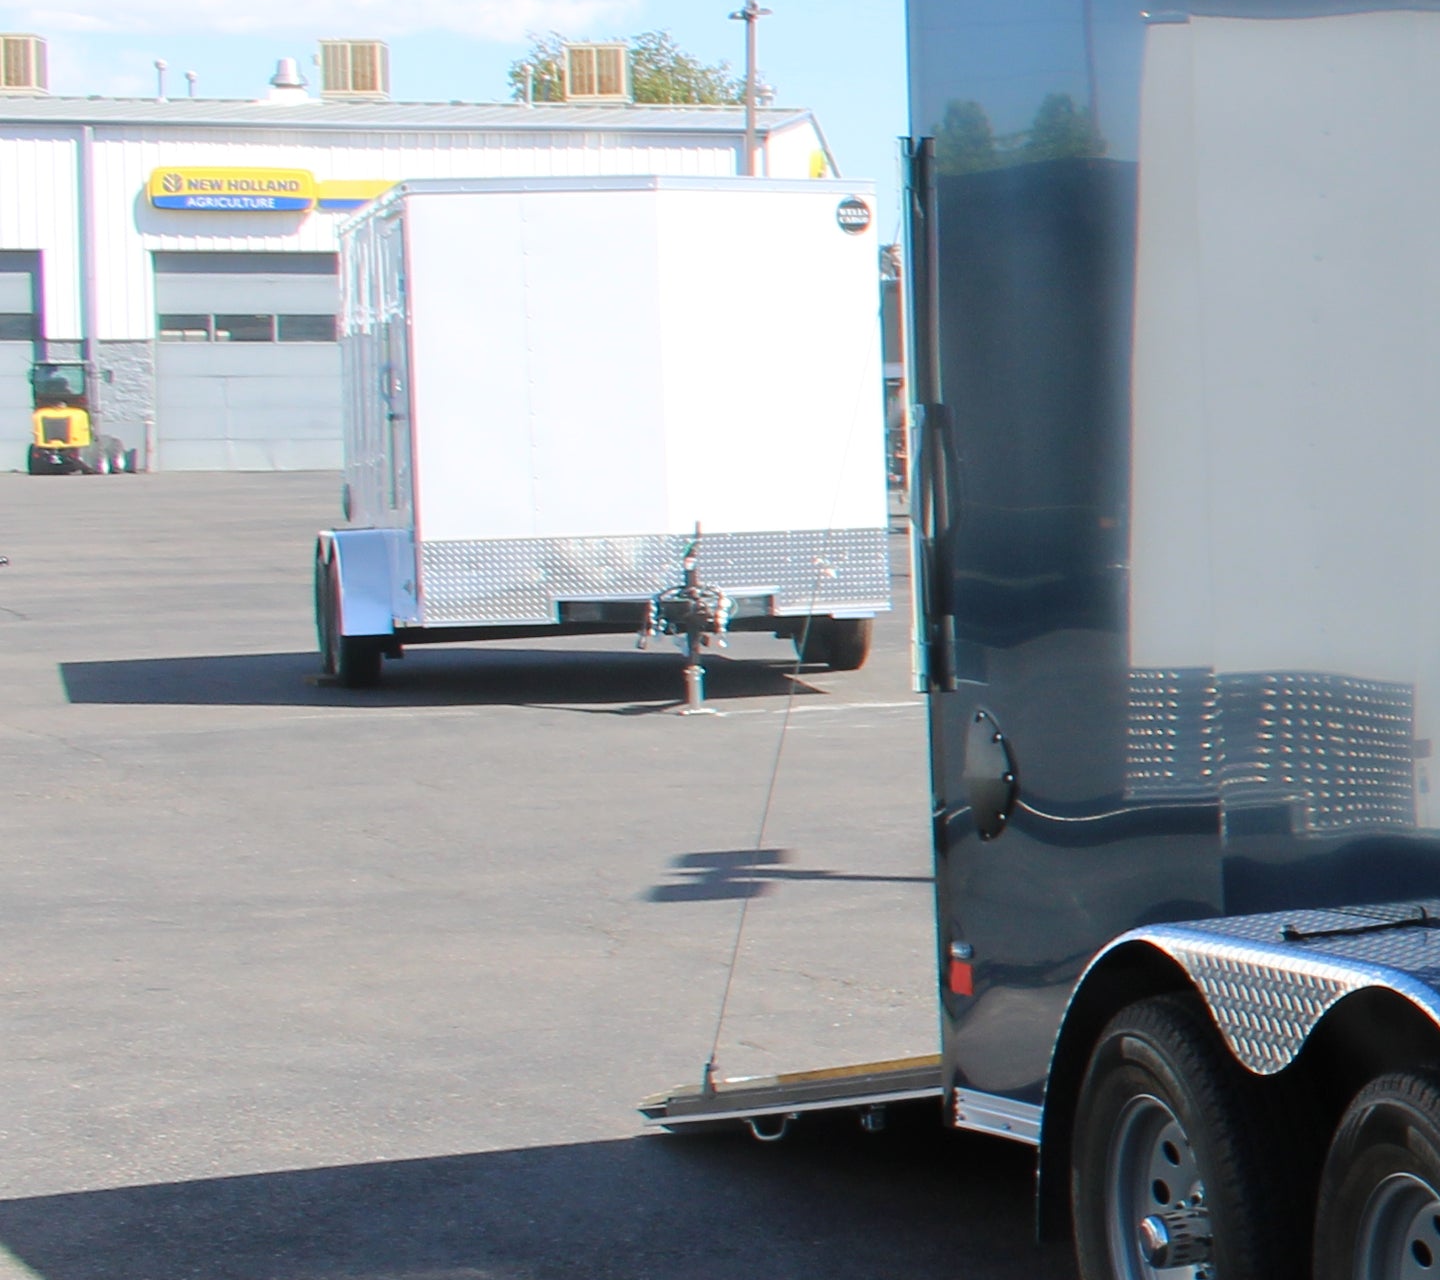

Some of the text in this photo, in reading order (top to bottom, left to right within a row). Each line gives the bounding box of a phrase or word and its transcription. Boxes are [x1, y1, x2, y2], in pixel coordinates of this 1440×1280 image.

[187, 178, 299, 192] NEW HOLLAND
[186, 197, 275, 209] AGRICULTURE
